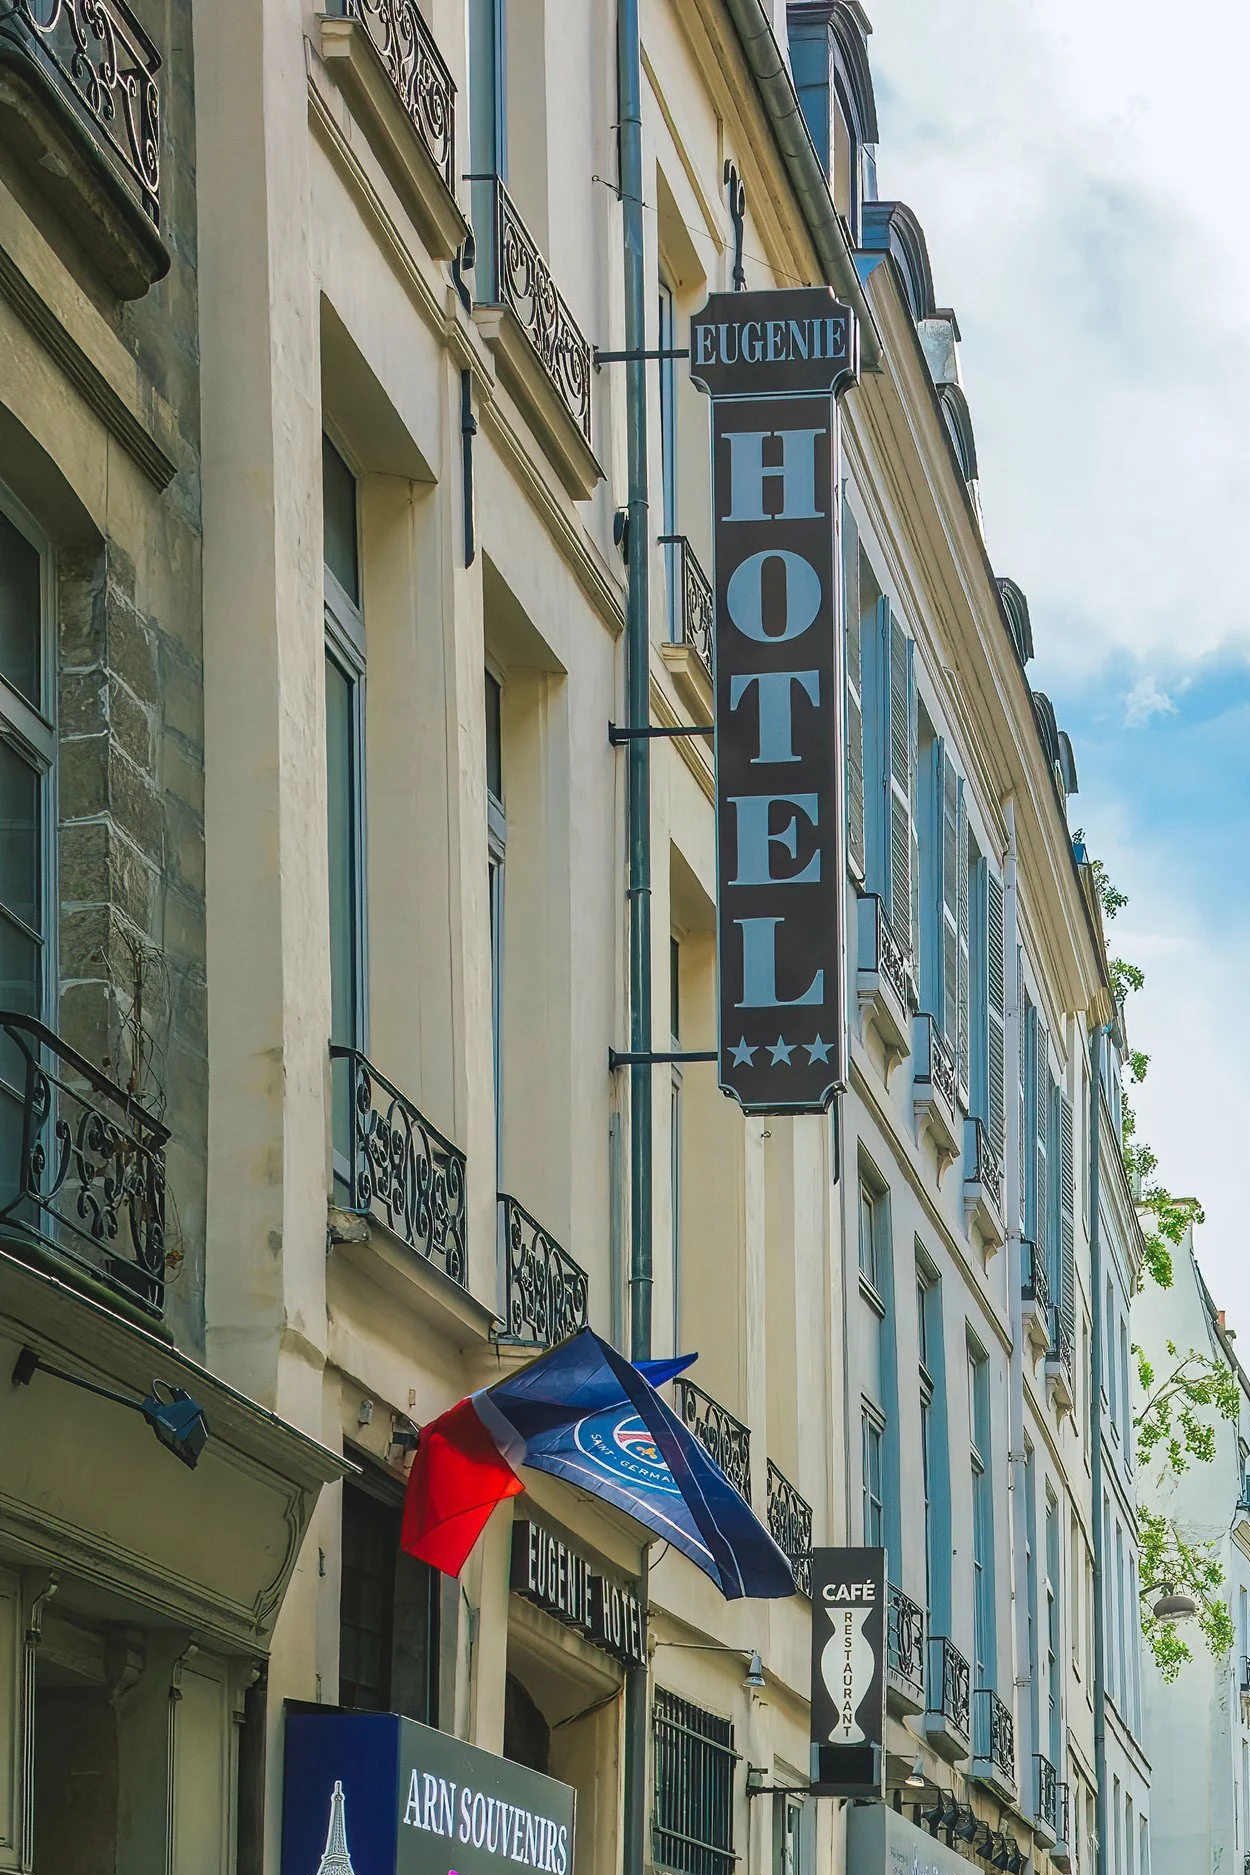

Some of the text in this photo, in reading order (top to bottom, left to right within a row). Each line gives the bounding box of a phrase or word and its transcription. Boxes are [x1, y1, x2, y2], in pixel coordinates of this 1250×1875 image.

[695, 317, 846, 365] EUGENIE
[720, 428, 827, 1008] HOTEL
[528, 1521, 646, 1665] EUGENIE HOTEL
[822, 1579, 876, 1601] CAFÉ
[842, 1611, 853, 1738] RESTAURANT
[402, 1768, 457, 1838] ARN
